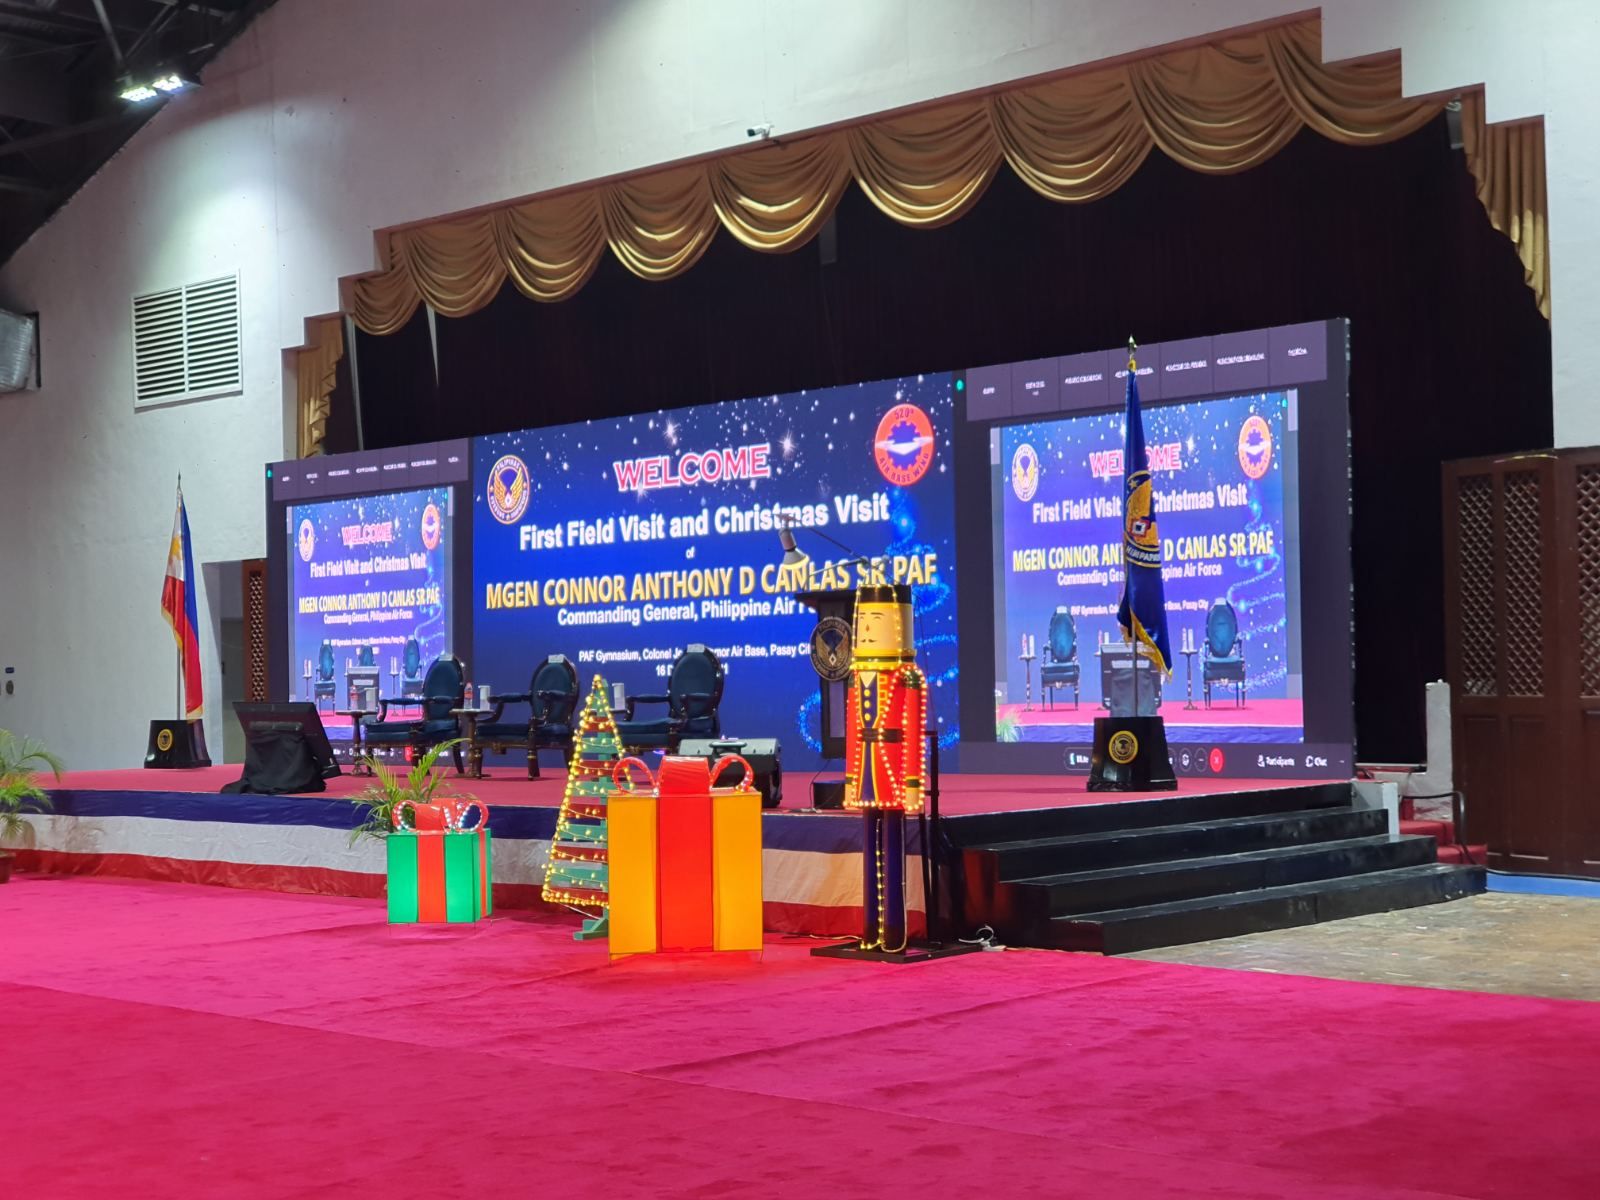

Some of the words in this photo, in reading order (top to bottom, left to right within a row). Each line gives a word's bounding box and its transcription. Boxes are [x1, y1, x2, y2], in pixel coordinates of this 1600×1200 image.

[613, 443, 771, 492] WELCOME
[1216, 483, 1248, 508] Visit
[520, 523, 562, 551] First
[567, 517, 614, 547] Field
[619, 513, 665, 543] Visit
[669, 507, 709, 538] and
[714, 502, 830, 534] Christmas
[834, 492, 890, 524] Visit
[1033, 501, 1060, 523] First
[1062, 498, 1091, 521] Field
[1094, 496, 1121, 519] Visit
[341, 521, 392, 545] WELCOME
[686, 546, 695, 559] of
[1164, 539, 1174, 561] D
[1176, 533, 1227, 560] CANLAS
[1229, 534, 1248, 557] SR
[1249, 530, 1274, 555] PAF
[310, 561, 326, 578] First
[360, 558, 373, 573] and
[374, 555, 409, 572] Christmas
[1013, 549, 1046, 572] MGEN
[1048, 546, 1099, 569] CONNOR
[1184, 563, 1196, 577] Air
[1197, 561, 1222, 576] Force
[486, 580, 539, 609] MGEN
[543, 574, 626, 606] CONNOR
[631, 566, 733, 602] ANTHONY
[740, 565, 755, 595] D
[761, 558, 850, 594] CANLAS
[856, 557, 886, 585] SR
[893, 553, 936, 586] PAF
[1057, 569, 1108, 586] Commanding
[299, 596, 318, 613] MGEN
[319, 594, 347, 611] CONNOR
[348, 592, 380, 610] ANTHONY
[382, 591, 387, 607] D
[388, 589, 415, 606] CANLAS
[416, 589, 426, 605] SR
[557, 605, 640, 626] Commanding
[643, 601, 698, 622] General,
[702, 600, 770, 621] Philippine
[774, 596, 796, 614] Air
[579, 650, 594, 662] PAF
[595, 648, 641, 664] Gymnasium,
[643, 647, 672, 660] Colonel
[731, 645, 743, 657] Air
[745, 645, 768, 658] Base,
[770, 644, 796, 659] Pasay
[656, 664, 666, 676] 16
